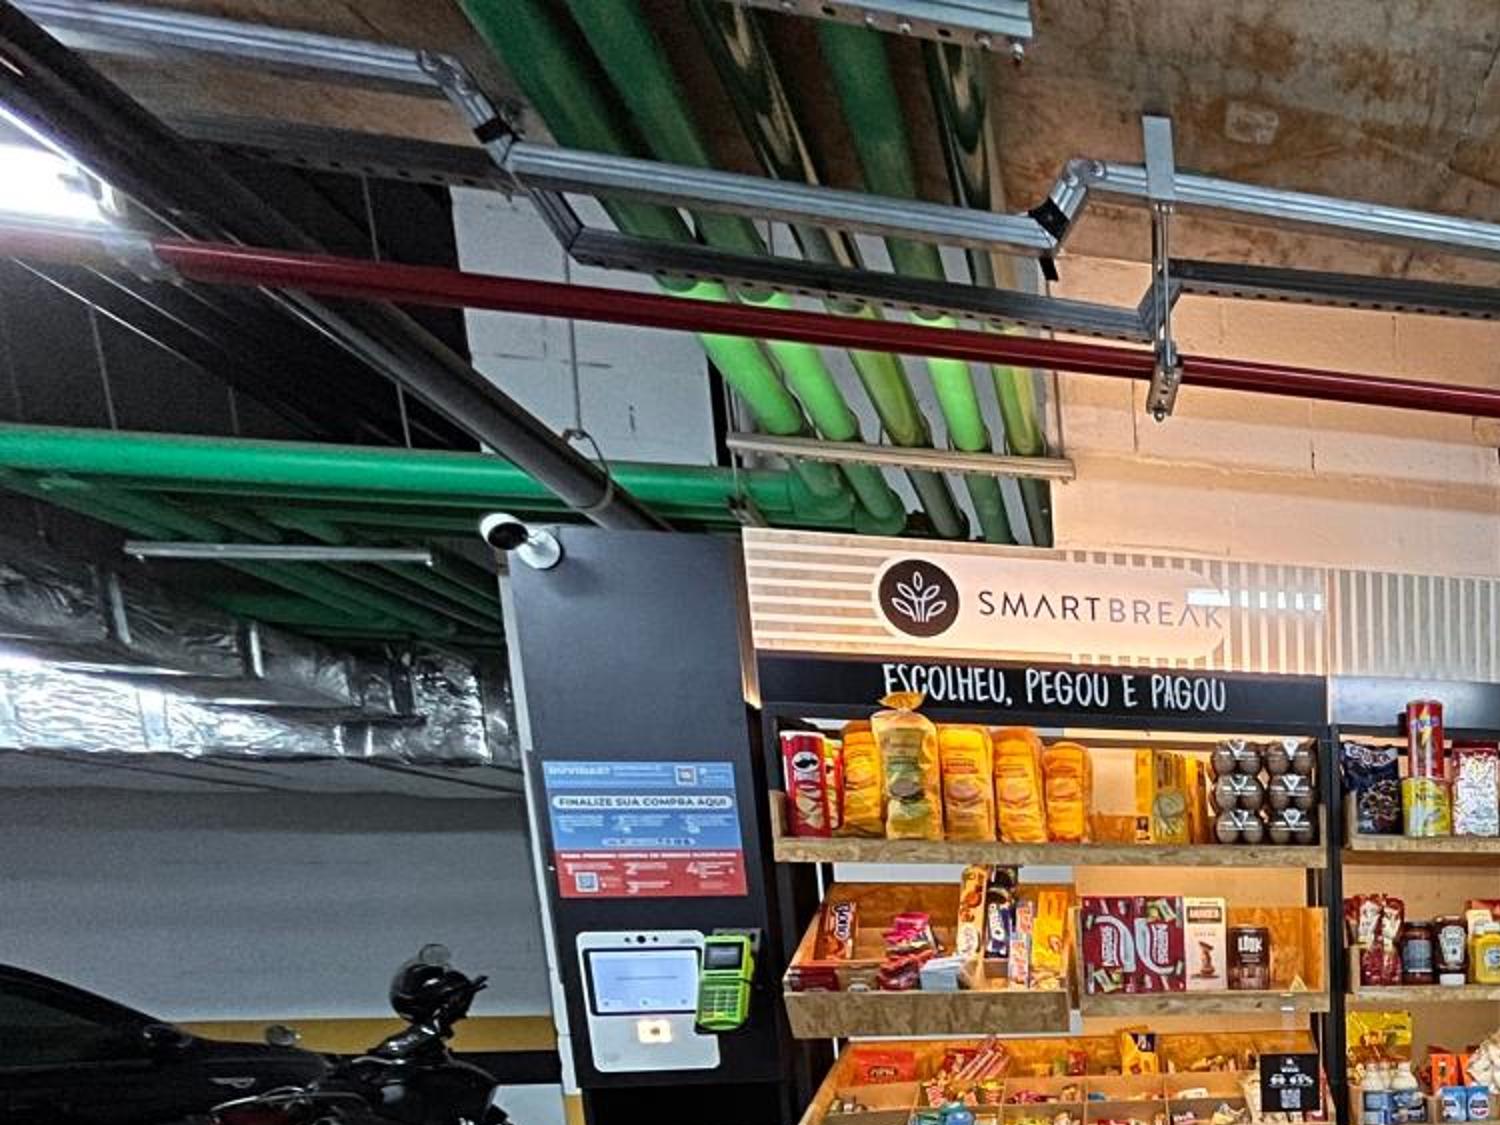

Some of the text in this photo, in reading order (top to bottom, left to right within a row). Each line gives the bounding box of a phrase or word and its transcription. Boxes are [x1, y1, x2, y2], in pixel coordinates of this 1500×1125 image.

[978, 591, 1223, 630] SMARTBREAK
[883, 663, 1226, 712] ESCOLHEU, PEGOU E PAGOU
[558, 798, 727, 807] FINALIZE SUA COMPRA AQUI
